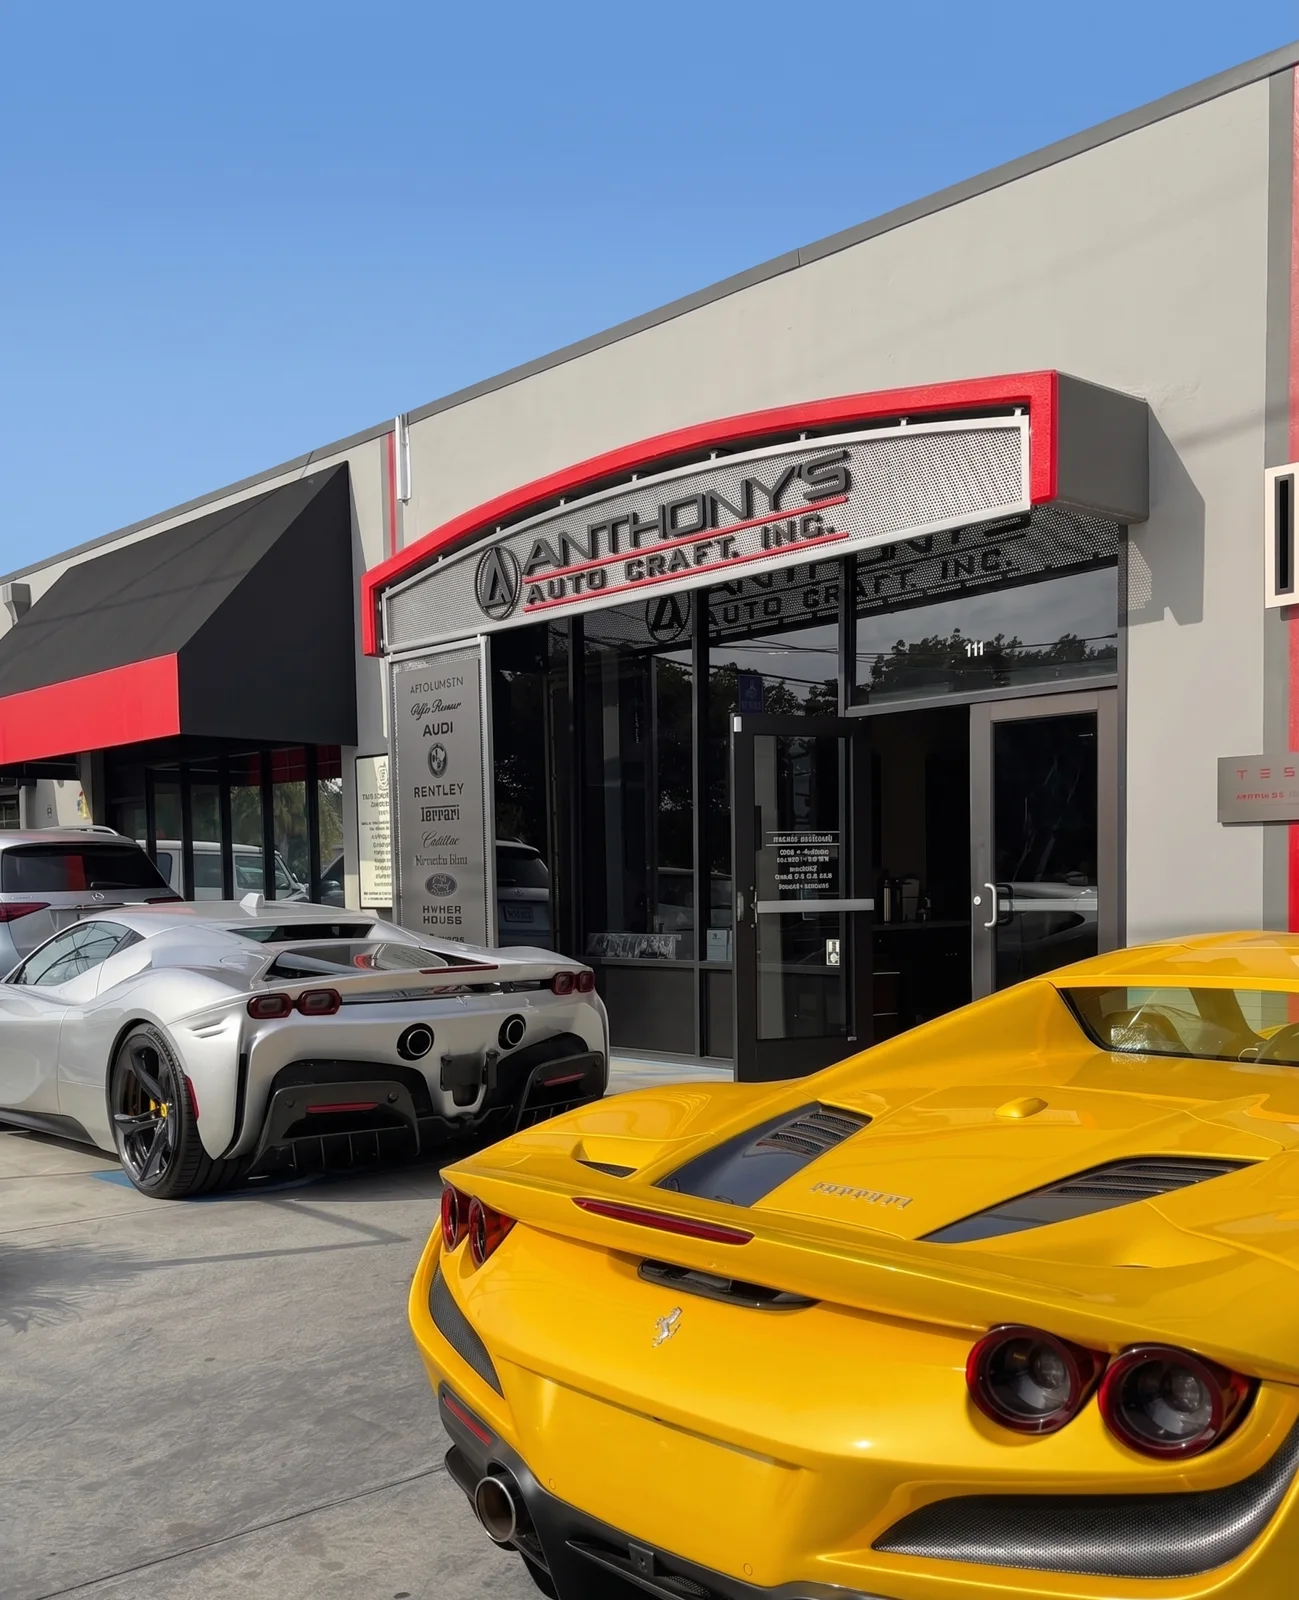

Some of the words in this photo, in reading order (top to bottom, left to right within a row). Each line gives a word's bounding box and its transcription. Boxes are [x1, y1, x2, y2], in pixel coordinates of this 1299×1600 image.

[522, 450, 847, 575] ANTHONY'S
[527, 568, 605, 605] AUTO
[625, 536, 739, 581] CRAFT.
[761, 513, 835, 550] INC.
[965, 641, 983, 657] 111
[422, 721, 453, 737] AUDI
[413, 782, 464, 798] RENTLEY
